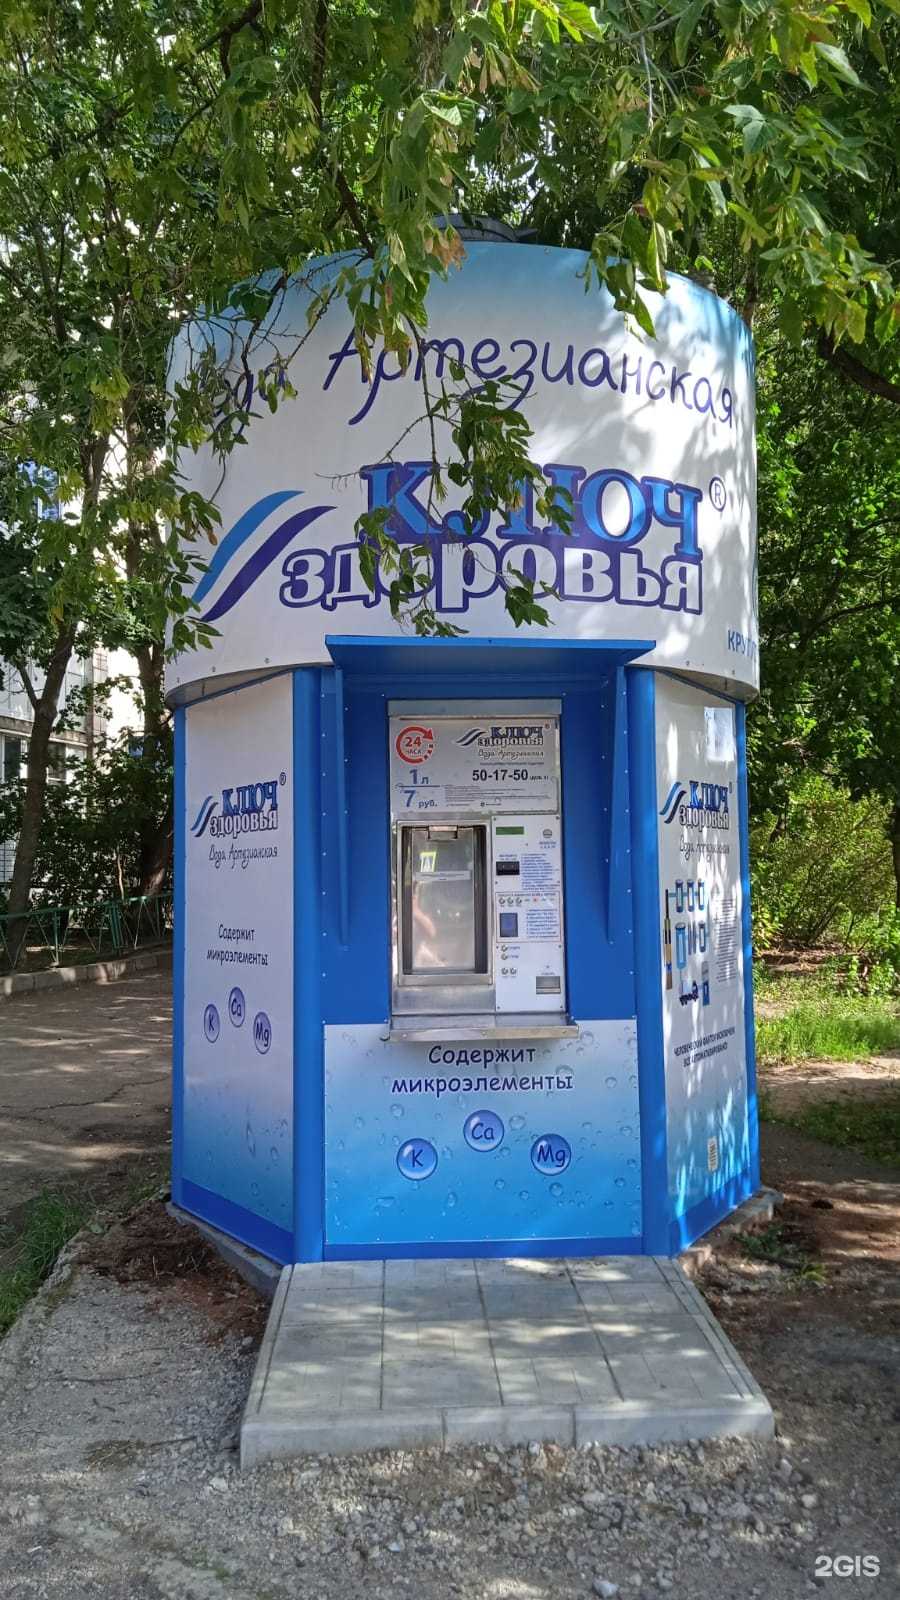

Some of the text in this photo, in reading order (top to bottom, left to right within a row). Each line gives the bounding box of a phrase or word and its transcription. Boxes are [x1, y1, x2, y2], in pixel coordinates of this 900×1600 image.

[323, 326, 733, 428] Артезианская
[279, 537, 703, 615] здоровья
[405, 736, 421, 747] 24
[490, 727, 543, 738] КЛЮЧ
[409, 768, 429, 785] 1 л
[472, 769, 528, 781] 50-17-50
[222, 780, 278, 816] КЛЮЧ
[403, 790, 438, 809] 7 руб.
[688, 780, 729, 813] КЛЮЧ
[209, 808, 279, 839] здоровья
[679, 804, 730, 832] здоровья
[218, 923, 255, 945] Содержит
[206, 949, 268, 967] микроэлементы
[231, 998, 242, 1017] Ca
[255, 1021, 270, 1047] Mg
[428, 1045, 536, 1069] Содержит
[392, 1074, 574, 1098] микроэлементы
[471, 1123, 495, 1140] Ca
[537, 1145, 566, 1168] Mg
